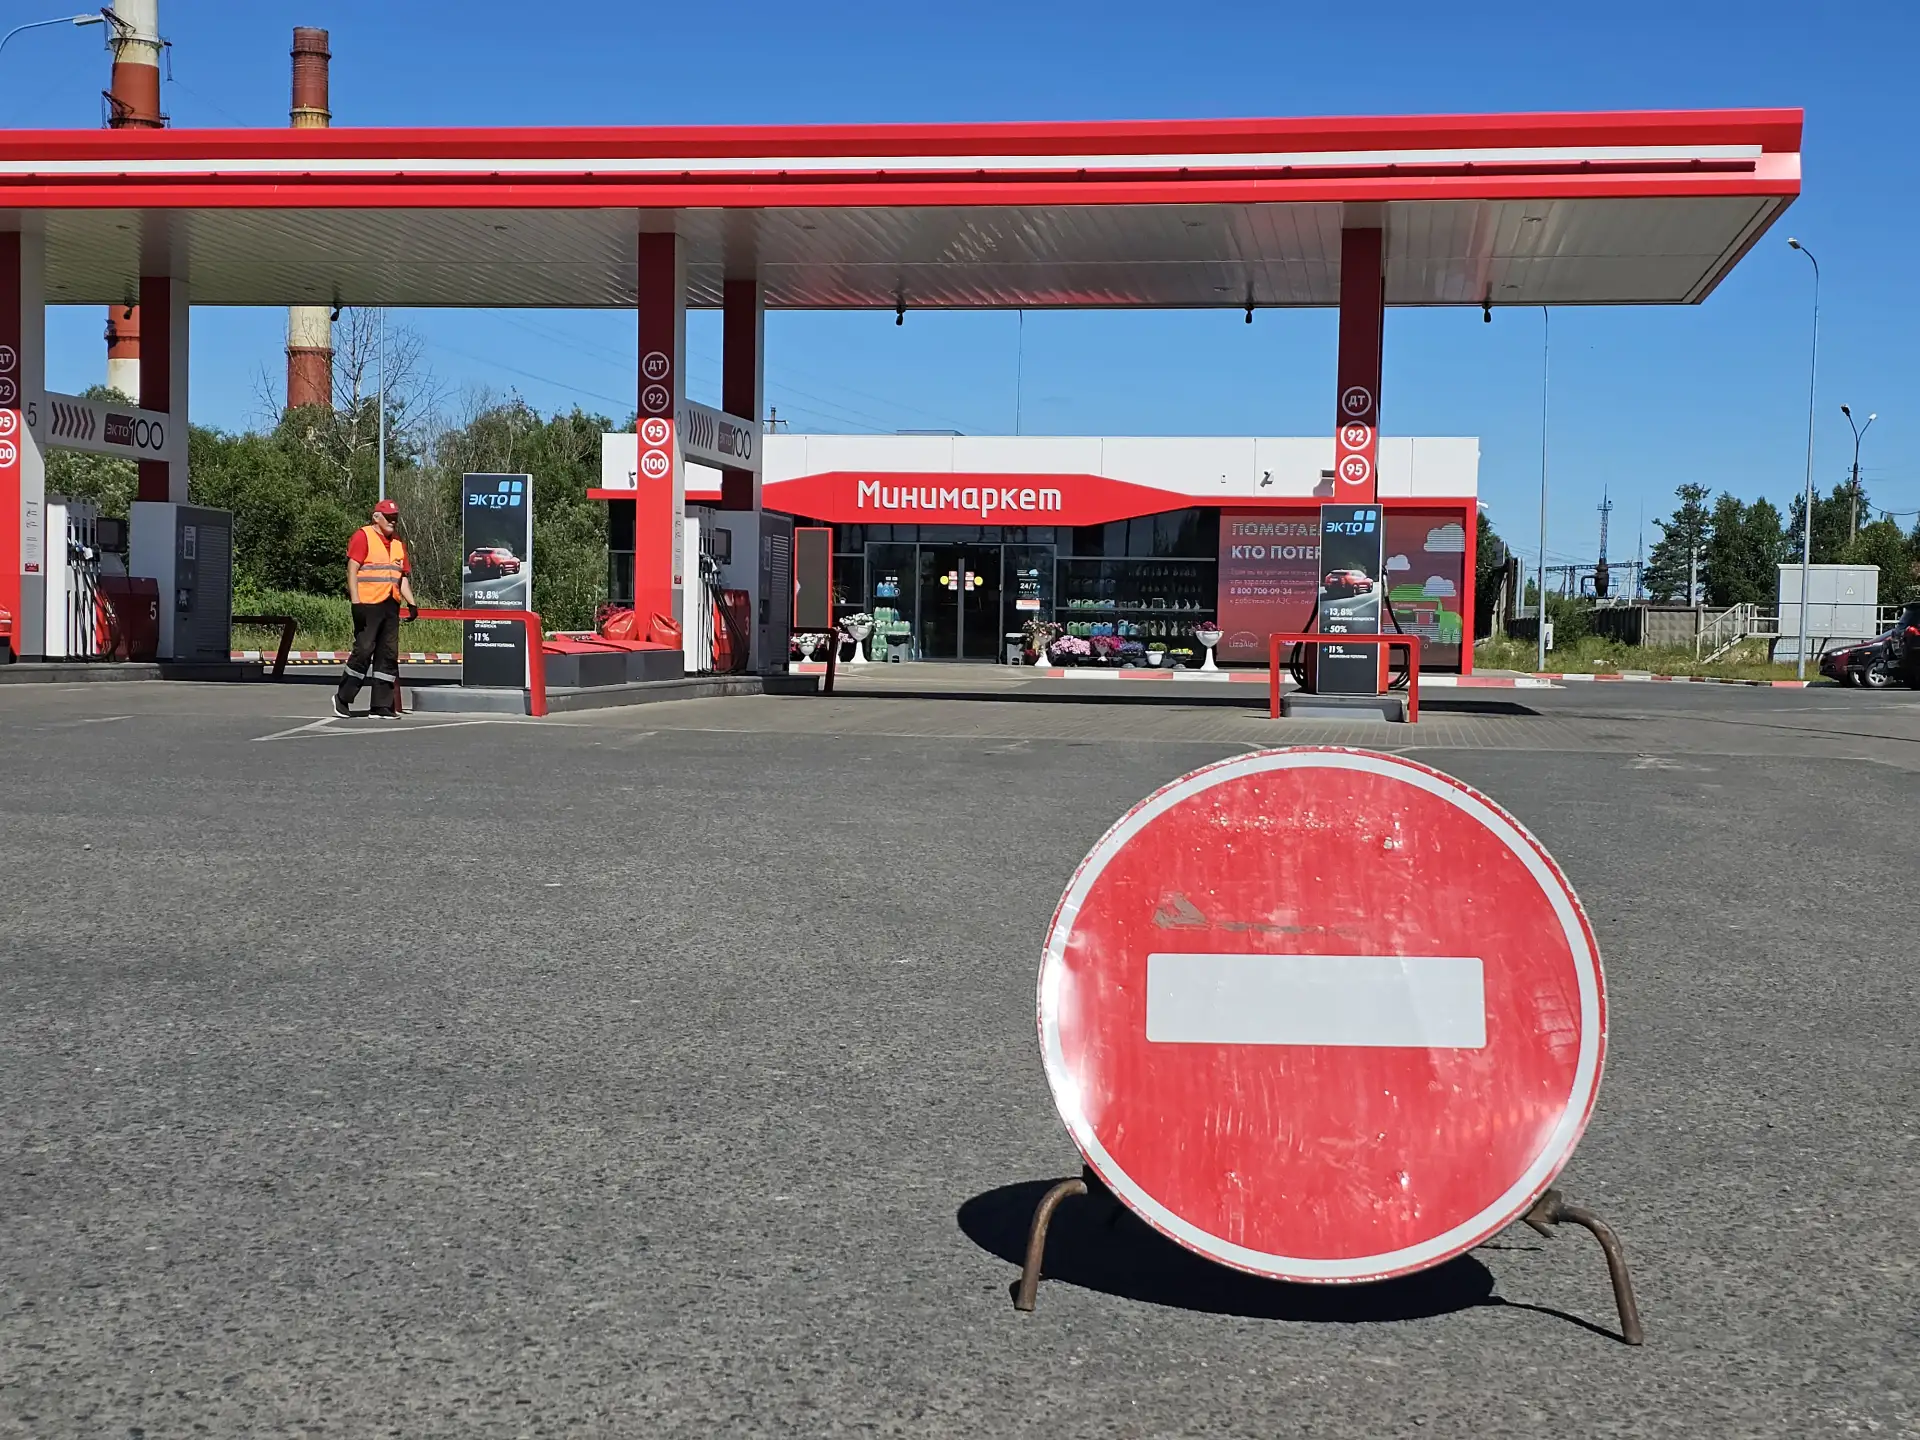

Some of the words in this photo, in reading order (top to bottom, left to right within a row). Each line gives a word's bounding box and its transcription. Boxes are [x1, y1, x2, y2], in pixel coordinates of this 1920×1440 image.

[648, 360, 664, 371] ДТ
[648, 393, 664, 404] 92
[1348, 395, 1366, 407] ДТ
[27, 402, 37, 427] 5
[106, 424, 129, 437] ЭКТО
[128, 417, 164, 451] 100
[647, 425, 664, 438] 95
[1347, 429, 1365, 442] 92
[731, 426, 752, 461] 100
[644, 458, 666, 470] 100
[1346, 463, 1363, 476] 95
[468, 494, 509, 506] ЭКТО
[857, 480, 1062, 518] Минимаркет
[1231, 522, 1320, 536] ПОМОГАЕ
[1326, 522, 1363, 533] ЭКТО
[1231, 545, 1266, 560] КТО
[1019, 582, 1037, 590] 24/7
[150, 601, 157, 620] 5
